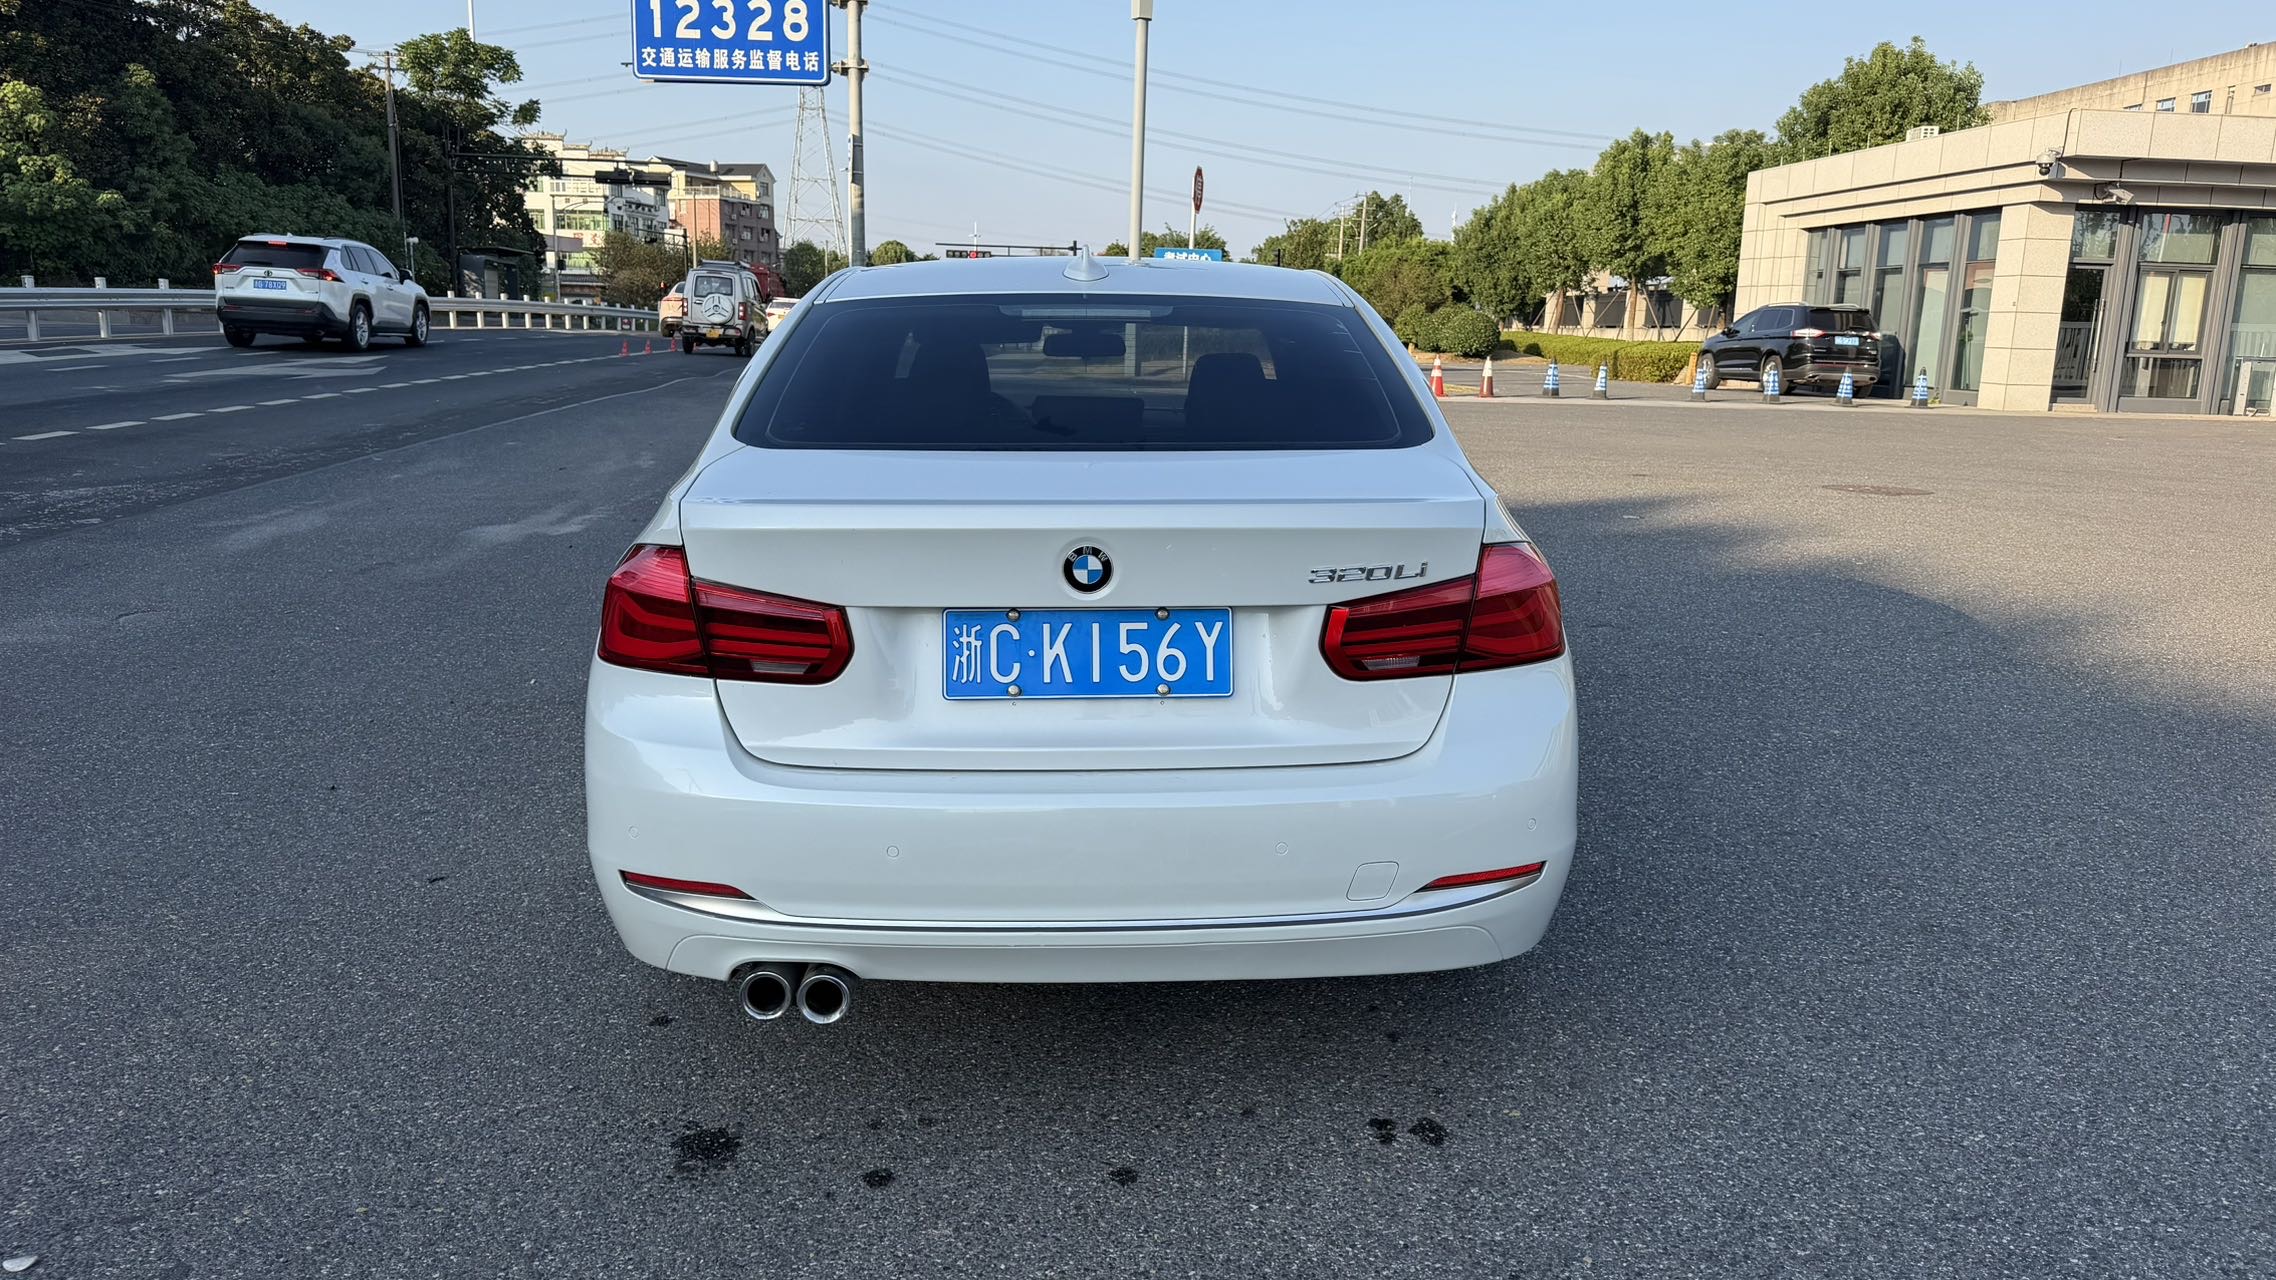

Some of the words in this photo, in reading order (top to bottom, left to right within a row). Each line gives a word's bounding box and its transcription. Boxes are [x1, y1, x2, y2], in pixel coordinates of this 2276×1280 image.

[649, 0, 809, 41] 12328
[641, 47, 819, 72] 交通运输服务监督电话
[1067, 546, 1108, 562] BMW
[1308, 562, 1428, 583] 320Li
[952, 621, 1223, 684] 浙C·K156Y
